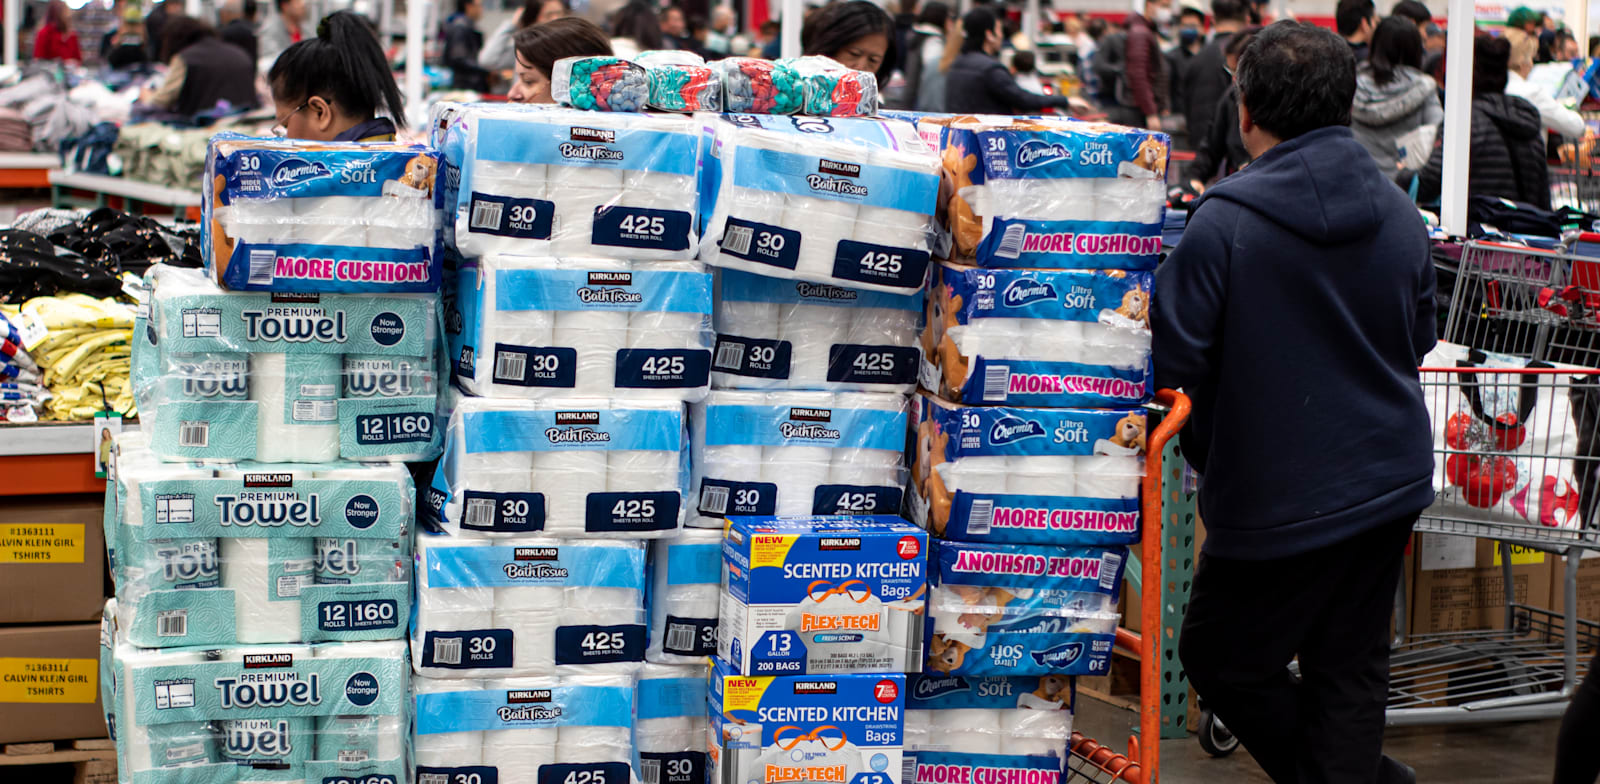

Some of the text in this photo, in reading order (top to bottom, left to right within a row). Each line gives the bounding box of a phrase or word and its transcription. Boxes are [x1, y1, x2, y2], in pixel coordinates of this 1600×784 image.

[988, 137, 1006, 151] 30
[1084, 142, 1108, 150] Ultra
[1019, 146, 1058, 162] Charmin
[1079, 149, 1113, 166] Soft
[240, 156, 260, 170] 30
[820, 160, 860, 173] KIRKLAND
[274, 162, 320, 182] Charmin
[340, 168, 377, 184] Soft
[509, 206, 536, 223] 30
[509, 222, 533, 230] ROLLS
[620, 214, 664, 235] 425
[757, 232, 785, 250] 30
[1024, 233, 1072, 253] MORE
[756, 248, 780, 258] ROLLS
[275, 258, 333, 278] MORE
[860, 252, 902, 272] 425
[590, 272, 631, 282] KIRKLAND
[978, 274, 995, 289] 30
[1008, 284, 1048, 301] Charmin
[1071, 286, 1092, 294] Ultra
[1064, 292, 1096, 310] Soft
[242, 310, 346, 341] Towel
[379, 318, 396, 327] Now
[372, 326, 403, 335] Stronger
[750, 346, 775, 362] 30
[853, 353, 894, 370] 425
[533, 356, 559, 372] 30
[642, 356, 685, 374] 425
[750, 362, 772, 370] ROLLS
[343, 363, 411, 397] wel
[1009, 374, 1063, 394] MORE
[558, 412, 598, 421] KIRKLAND
[792, 408, 830, 418] KIRKLAND
[361, 418, 384, 434] 12
[393, 416, 430, 434] 160
[962, 414, 980, 428] 30
[1060, 420, 1084, 428] Ultra
[994, 423, 1034, 441] Charmin
[1054, 427, 1088, 443] Soft
[246, 474, 292, 482] KIRKLAND
[354, 501, 370, 509] Now
[734, 490, 760, 506] 30
[836, 492, 876, 511] 425
[215, 494, 320, 526] Towel
[347, 508, 378, 518] Stronger
[502, 500, 529, 517] 30
[612, 500, 655, 518] 425
[504, 516, 526, 524] ROLLS
[993, 508, 1047, 528] MORE
[25, 538, 52, 547] KLEIN
[54, 538, 74, 547] GIRL
[755, 536, 784, 544] NEW
[820, 538, 860, 546] KIRKLAND
[900, 540, 907, 554] 7
[13, 552, 51, 560] TSHIRTS
[516, 548, 557, 557] KIRKLAND
[784, 562, 920, 579] SCENTED KITCHEN
[952, 550, 1101, 579] MORE CUSHIONY
[881, 584, 911, 599] Bags
[323, 604, 346, 621] 12
[354, 603, 394, 621] 160
[324, 620, 346, 628] ROLLS
[802, 612, 880, 632] FLEX-TECH
[469, 636, 496, 653] 30
[581, 632, 625, 650] 425
[768, 634, 792, 651] 13
[246, 654, 292, 664] KIRKLAND
[470, 652, 494, 660] ROLLS
[990, 644, 1024, 659] Soft
[758, 662, 800, 671] 200 BAGS
[994, 659, 1018, 668] Ultra
[4, 674, 38, 682] CALVIN
[68, 675, 88, 683] GIRL
[354, 679, 371, 688] Now
[728, 680, 757, 688] NEW
[796, 682, 836, 690] KIRKLAND
[918, 676, 958, 694] Charmin
[27, 688, 64, 696] TSHIRTS
[216, 674, 320, 707] Towel
[347, 686, 378, 695] Stronger
[509, 690, 550, 700] KIRKLAND
[876, 685, 884, 698] 7
[978, 682, 1013, 696] Soft
[758, 706, 898, 722] SCENTED KITCHEN
[866, 730, 896, 744] Bags
[667, 759, 692, 775] 30
[765, 764, 847, 783] FLEX-TECH
[916, 764, 972, 784] MORE
[455, 773, 481, 784] 30
[564, 770, 605, 784] 425
[668, 775, 690, 783] ROLLS
